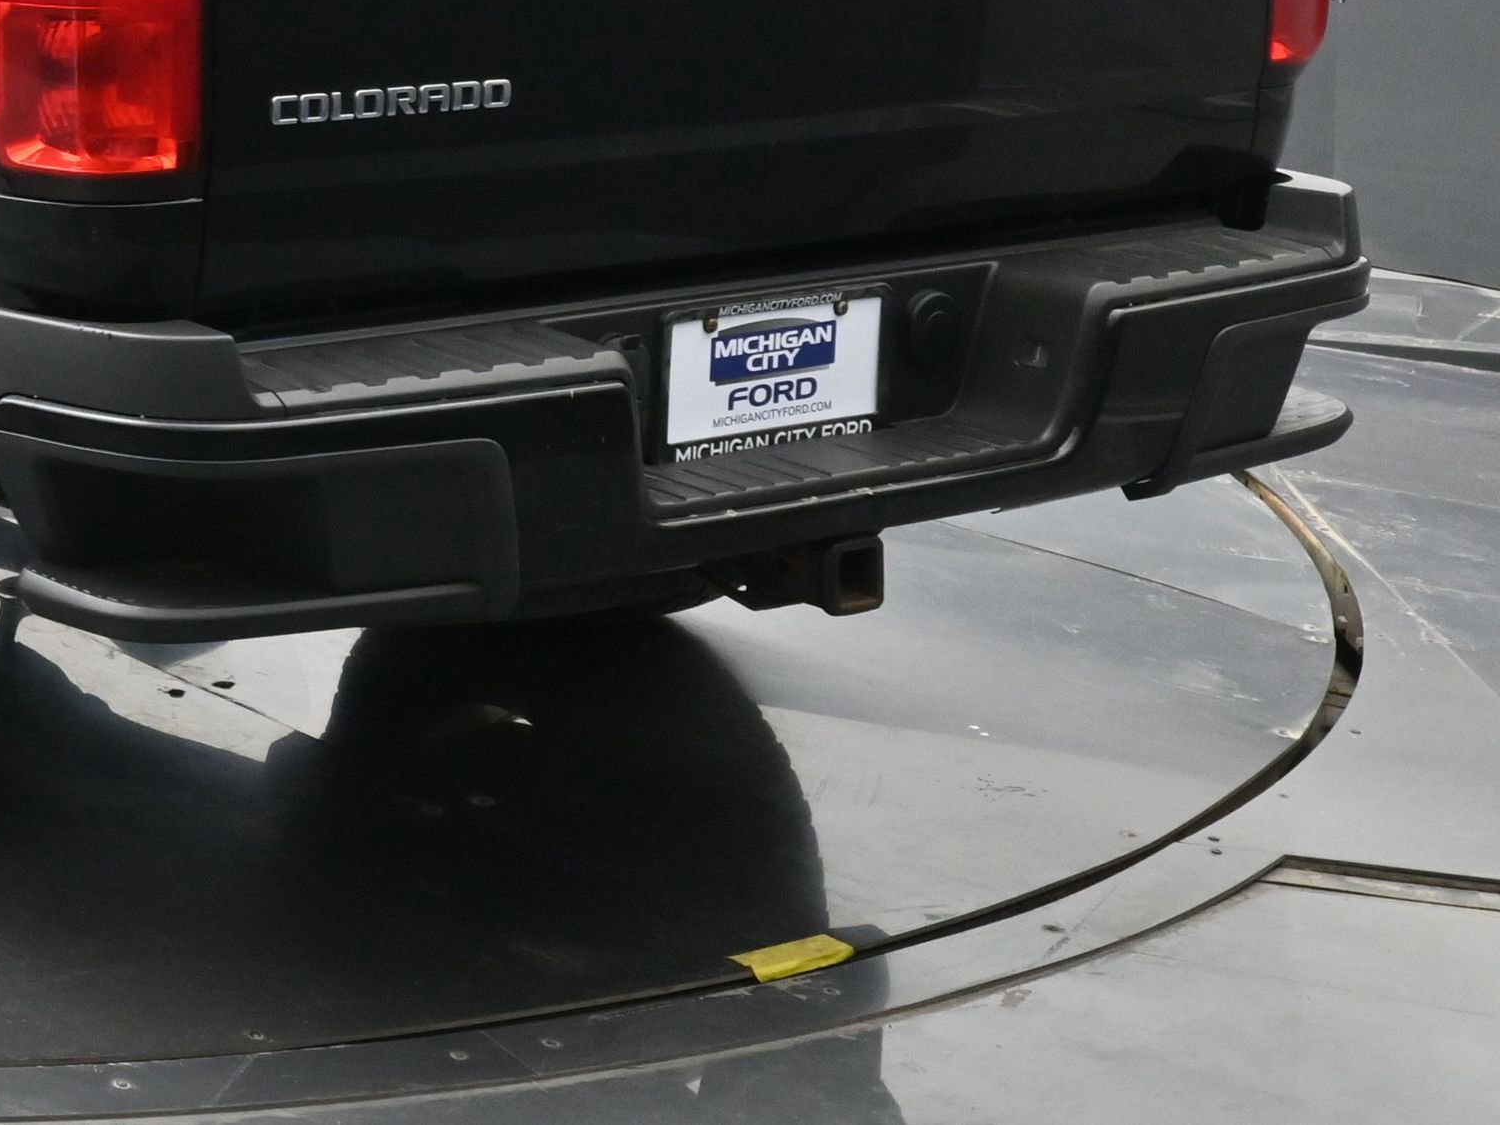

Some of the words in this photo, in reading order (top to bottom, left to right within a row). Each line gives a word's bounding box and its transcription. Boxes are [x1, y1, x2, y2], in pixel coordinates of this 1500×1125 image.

[271, 78, 512, 125] COLORADO
[718, 291, 843, 317] MICHIGANCITYFORD.COM
[714, 324, 833, 359] MICHIGAN
[745, 347, 800, 372] CITY
[727, 377, 818, 411] FORD
[712, 400, 833, 428] MICHIGANCITYFORD.COM
